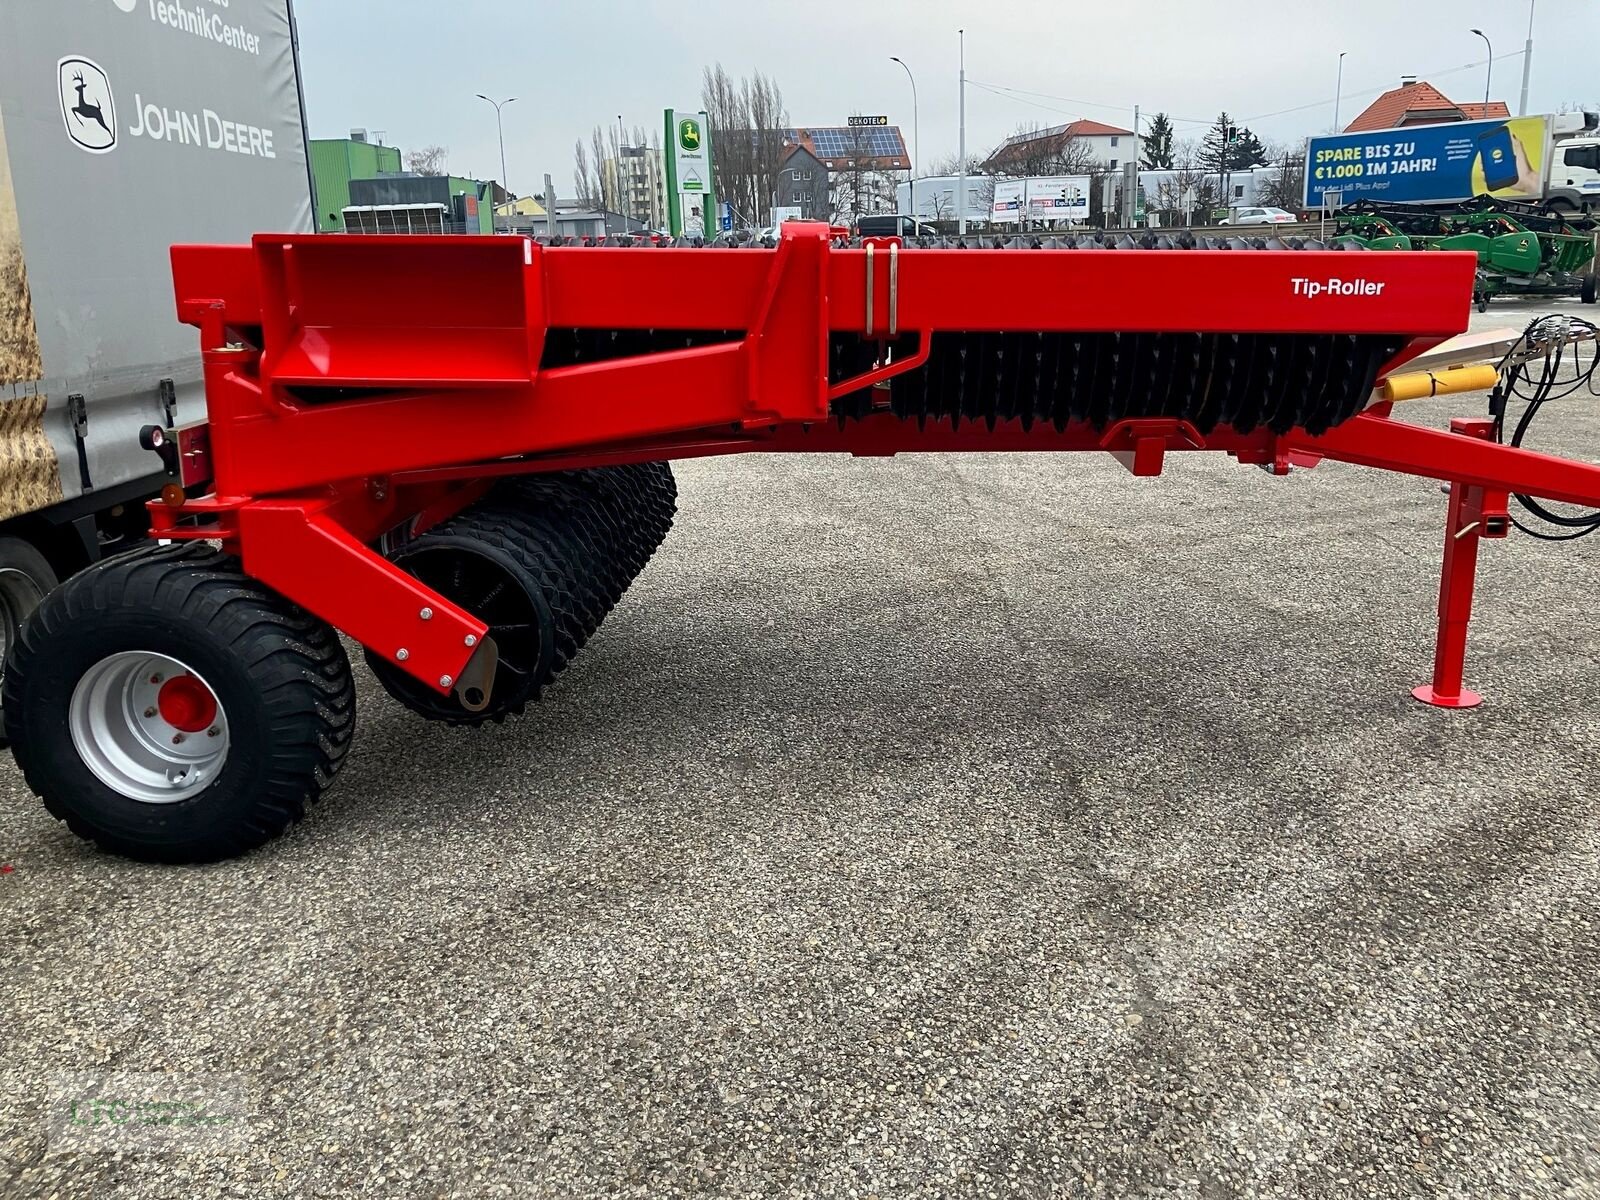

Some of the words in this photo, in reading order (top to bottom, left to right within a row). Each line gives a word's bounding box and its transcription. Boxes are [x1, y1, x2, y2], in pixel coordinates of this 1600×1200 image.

[149, 0, 260, 55] TechnikCenter
[129, 93, 201, 146] JOHN
[203, 108, 276, 158] DEERE
[1316, 147, 1362, 163] SPARE
[1365, 144, 1391, 159] BIS
[1393, 142, 1416, 157] ZU
[1366, 161, 1388, 176] IM
[1390, 158, 1437, 174] JAHR!
[1291, 278, 1385, 299] Tip-Roller
